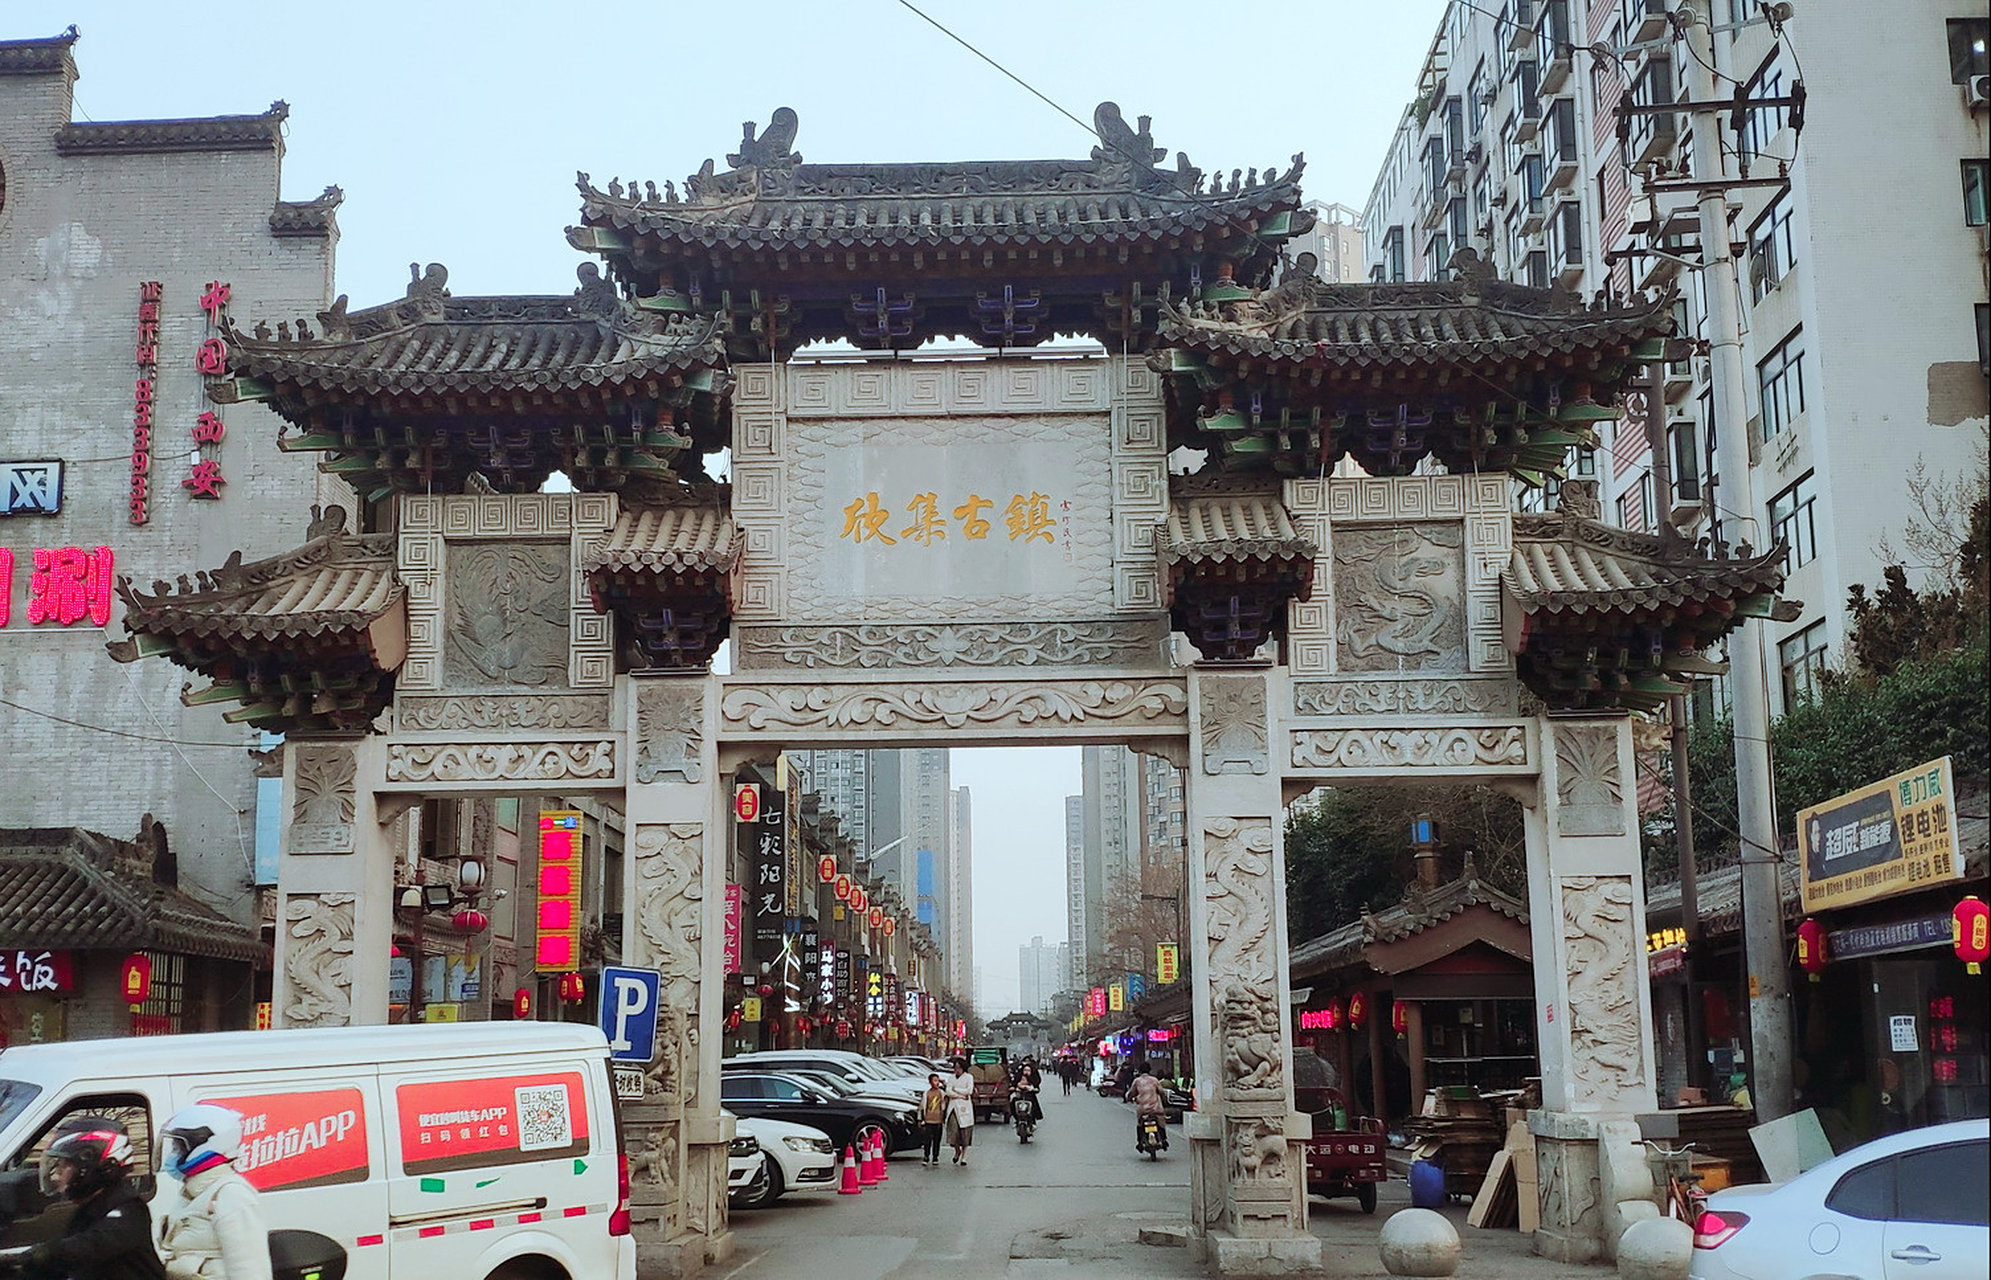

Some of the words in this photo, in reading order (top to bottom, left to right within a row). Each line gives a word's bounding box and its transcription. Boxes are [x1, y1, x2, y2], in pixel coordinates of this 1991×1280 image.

[182, 280, 231, 500] 中国西安
[757, 805, 782, 917] 七彩阳光
[1901, 803, 1947, 845] 锂电池
[611, 977, 649, 1051] P
